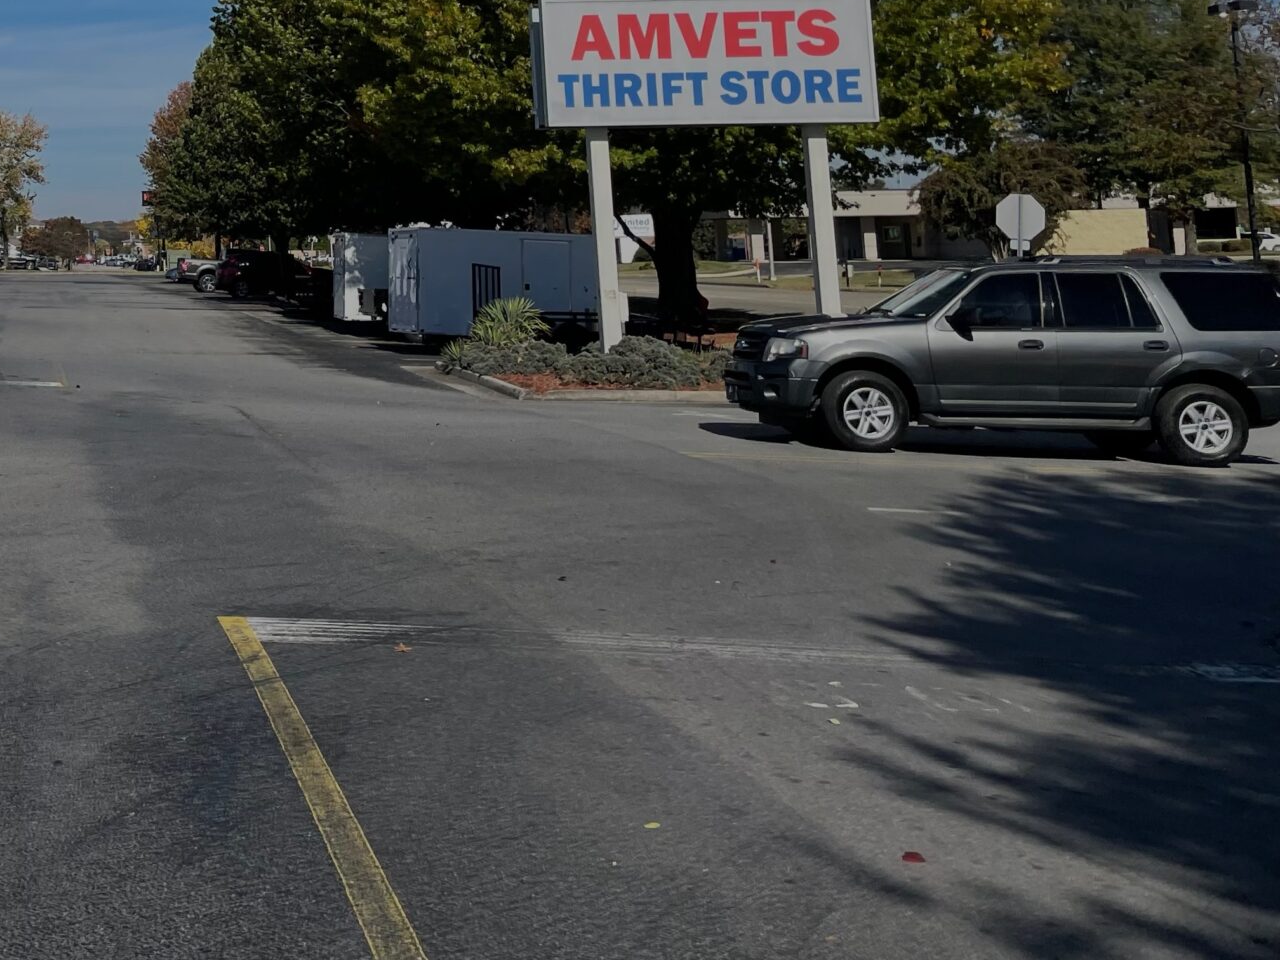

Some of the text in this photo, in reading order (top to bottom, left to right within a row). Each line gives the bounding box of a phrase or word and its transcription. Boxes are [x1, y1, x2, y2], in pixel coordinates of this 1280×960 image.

[571, 9, 840, 61] AMVETS
[558, 68, 863, 108] THRIFT STORE
